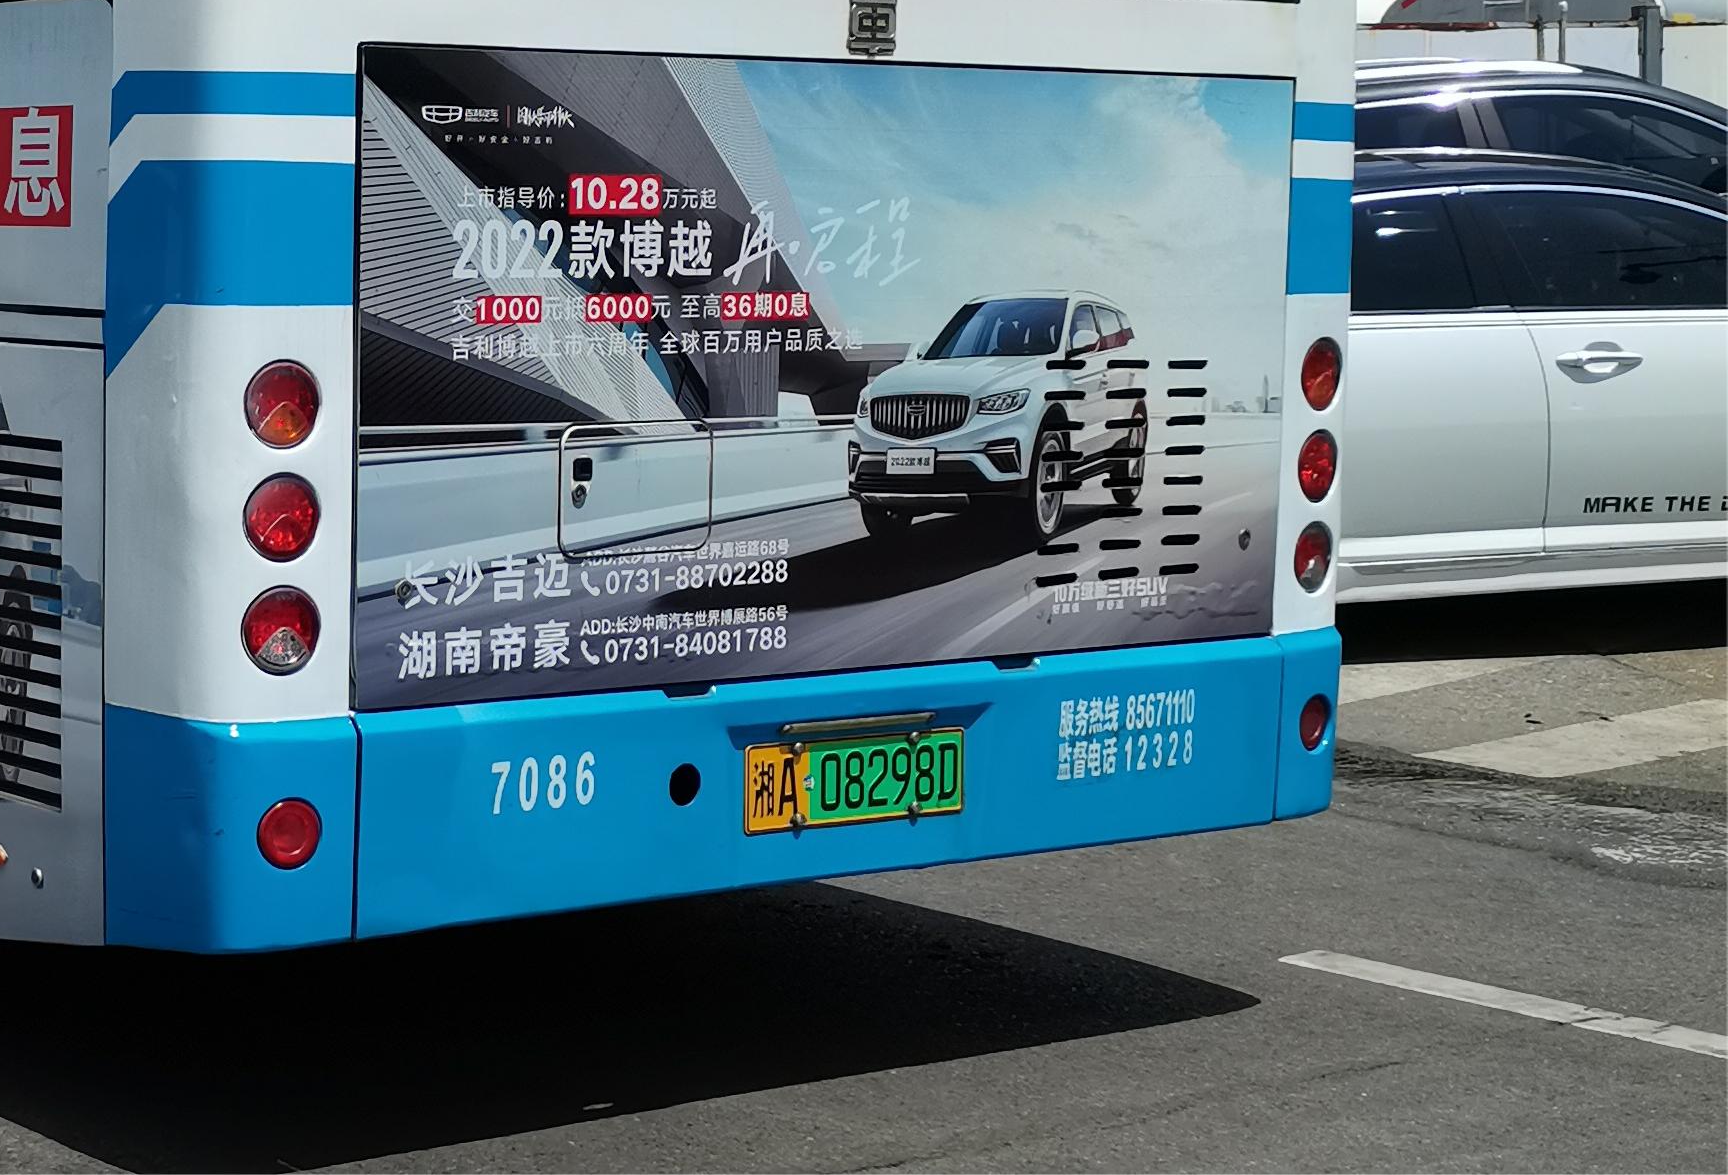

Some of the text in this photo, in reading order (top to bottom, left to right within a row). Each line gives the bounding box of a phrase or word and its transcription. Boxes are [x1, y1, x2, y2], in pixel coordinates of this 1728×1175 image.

[452, 218, 714, 281] 2022款博越
[452, 291, 810, 324] 交1000元抵6000元 至高36期0息
[451, 326, 864, 362] 吉利博越上市六周年 全球百万用户品质之选
[1583, 496, 1654, 513] MAKE
[1664, 495, 1712, 512] THE
[401, 551, 572, 611] 长沙吉迈
[604, 559, 789, 597] 0731-88702288
[398, 619, 571, 681] 湖南帝豪
[604, 626, 788, 665] 0731-84081788
[1058, 688, 1195, 738] 服务热线 85671110
[1056, 729, 1193, 781] 监督电话 12328
[489, 748, 597, 816] 7086
